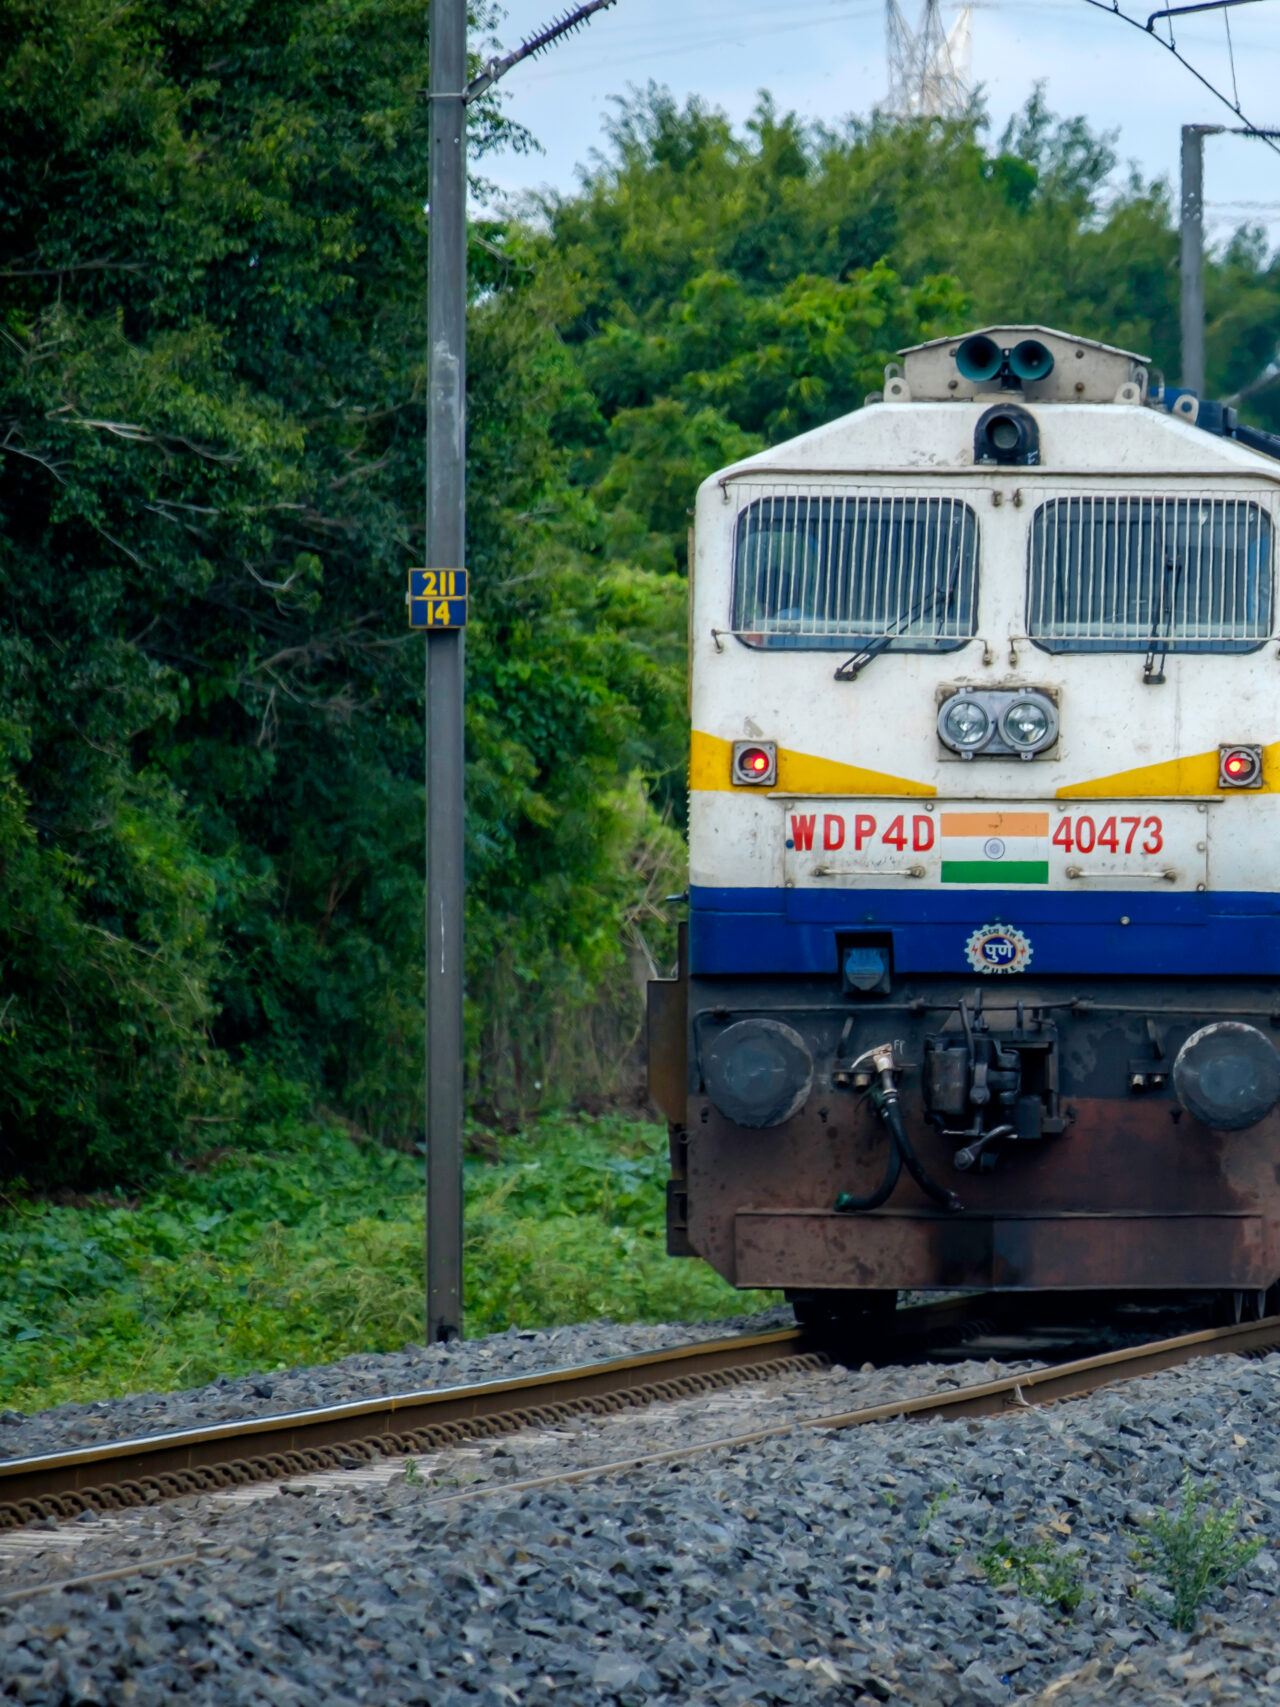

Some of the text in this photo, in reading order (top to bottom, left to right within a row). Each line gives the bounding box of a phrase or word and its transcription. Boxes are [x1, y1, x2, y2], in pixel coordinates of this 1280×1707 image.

[421, 571, 456, 596] 211
[427, 600, 451, 626] 14
[790, 813, 1164, 855] WDP4D 40473
[984, 938, 1014, 963] पुणे
[981, 964, 1017, 975] PUNE
